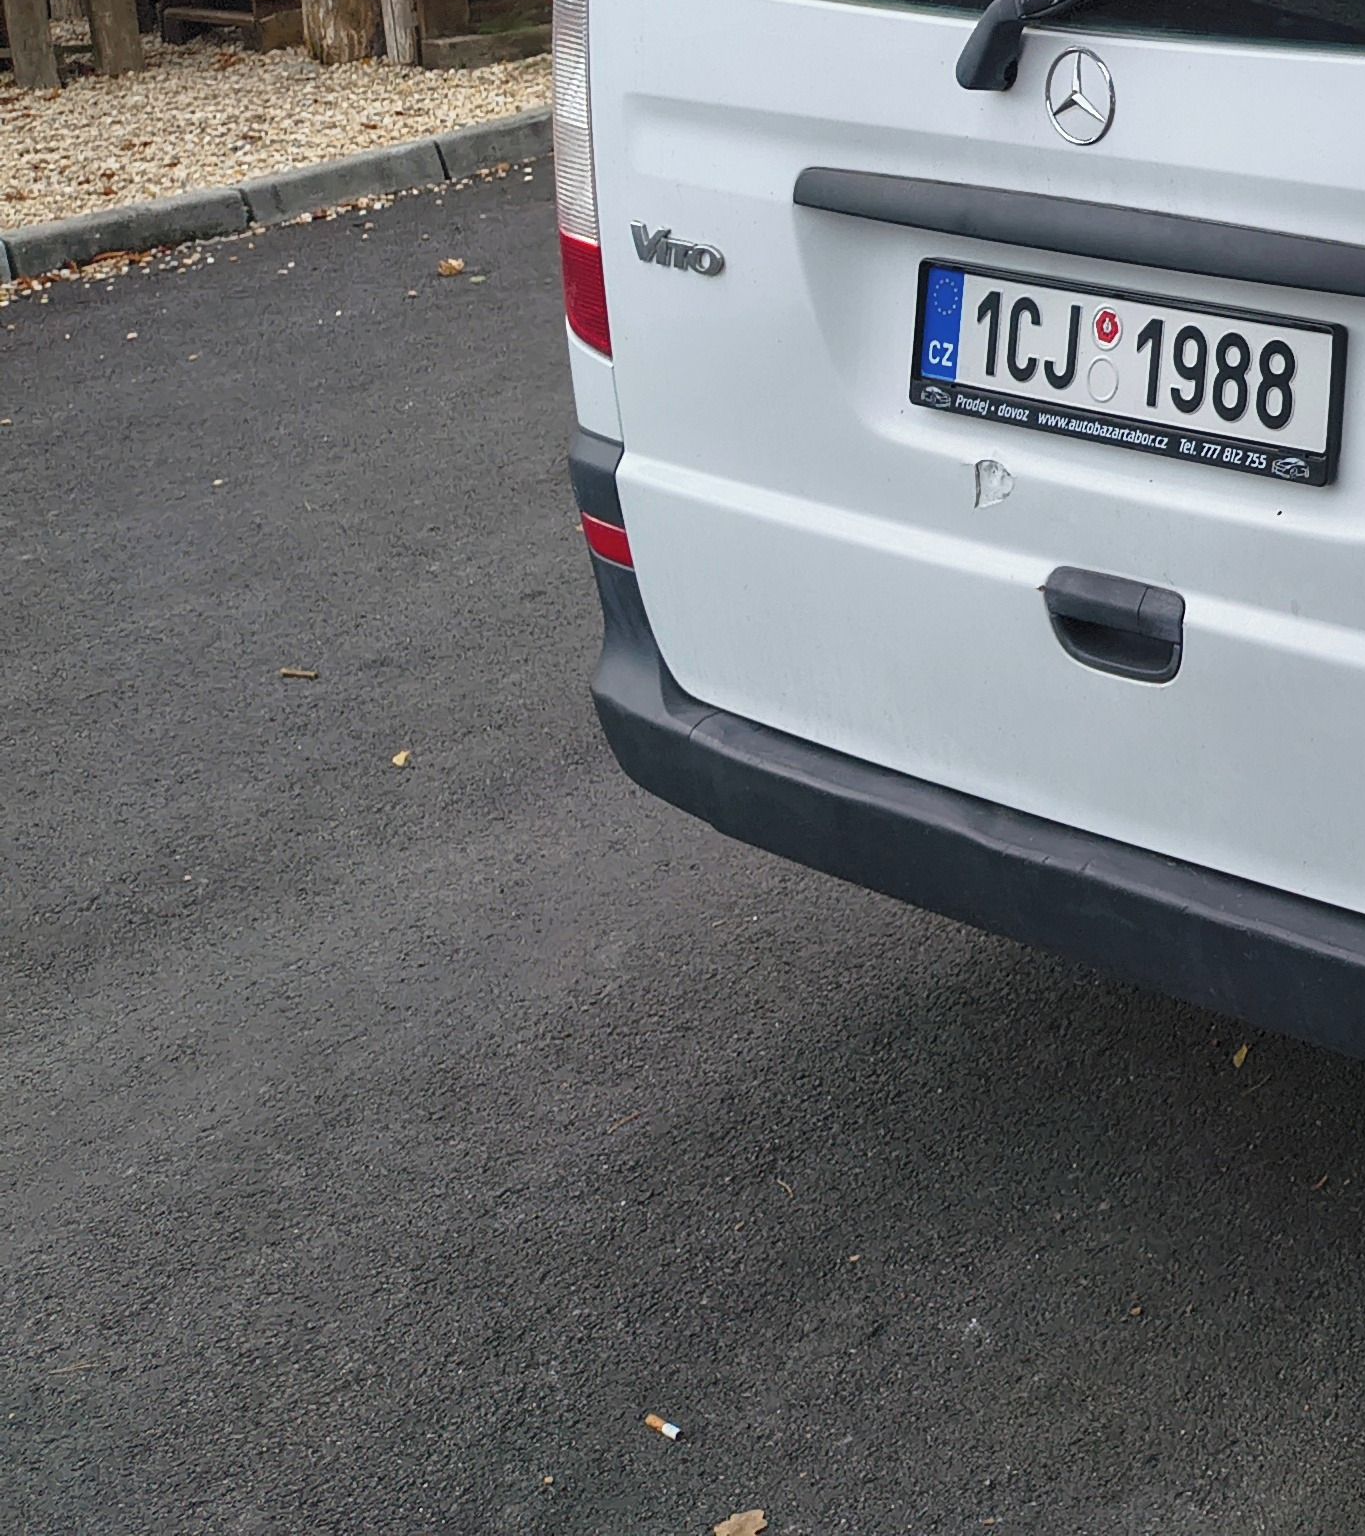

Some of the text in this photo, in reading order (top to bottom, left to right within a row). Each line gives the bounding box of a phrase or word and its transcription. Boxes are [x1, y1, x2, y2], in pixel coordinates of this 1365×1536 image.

[928, 339, 954, 367] CZ
[977, 290, 1298, 430] 1CJ 1988
[955, 394, 1267, 469] Prodej dovoz www.autobazartabor.cz Tel. 777 812 755
